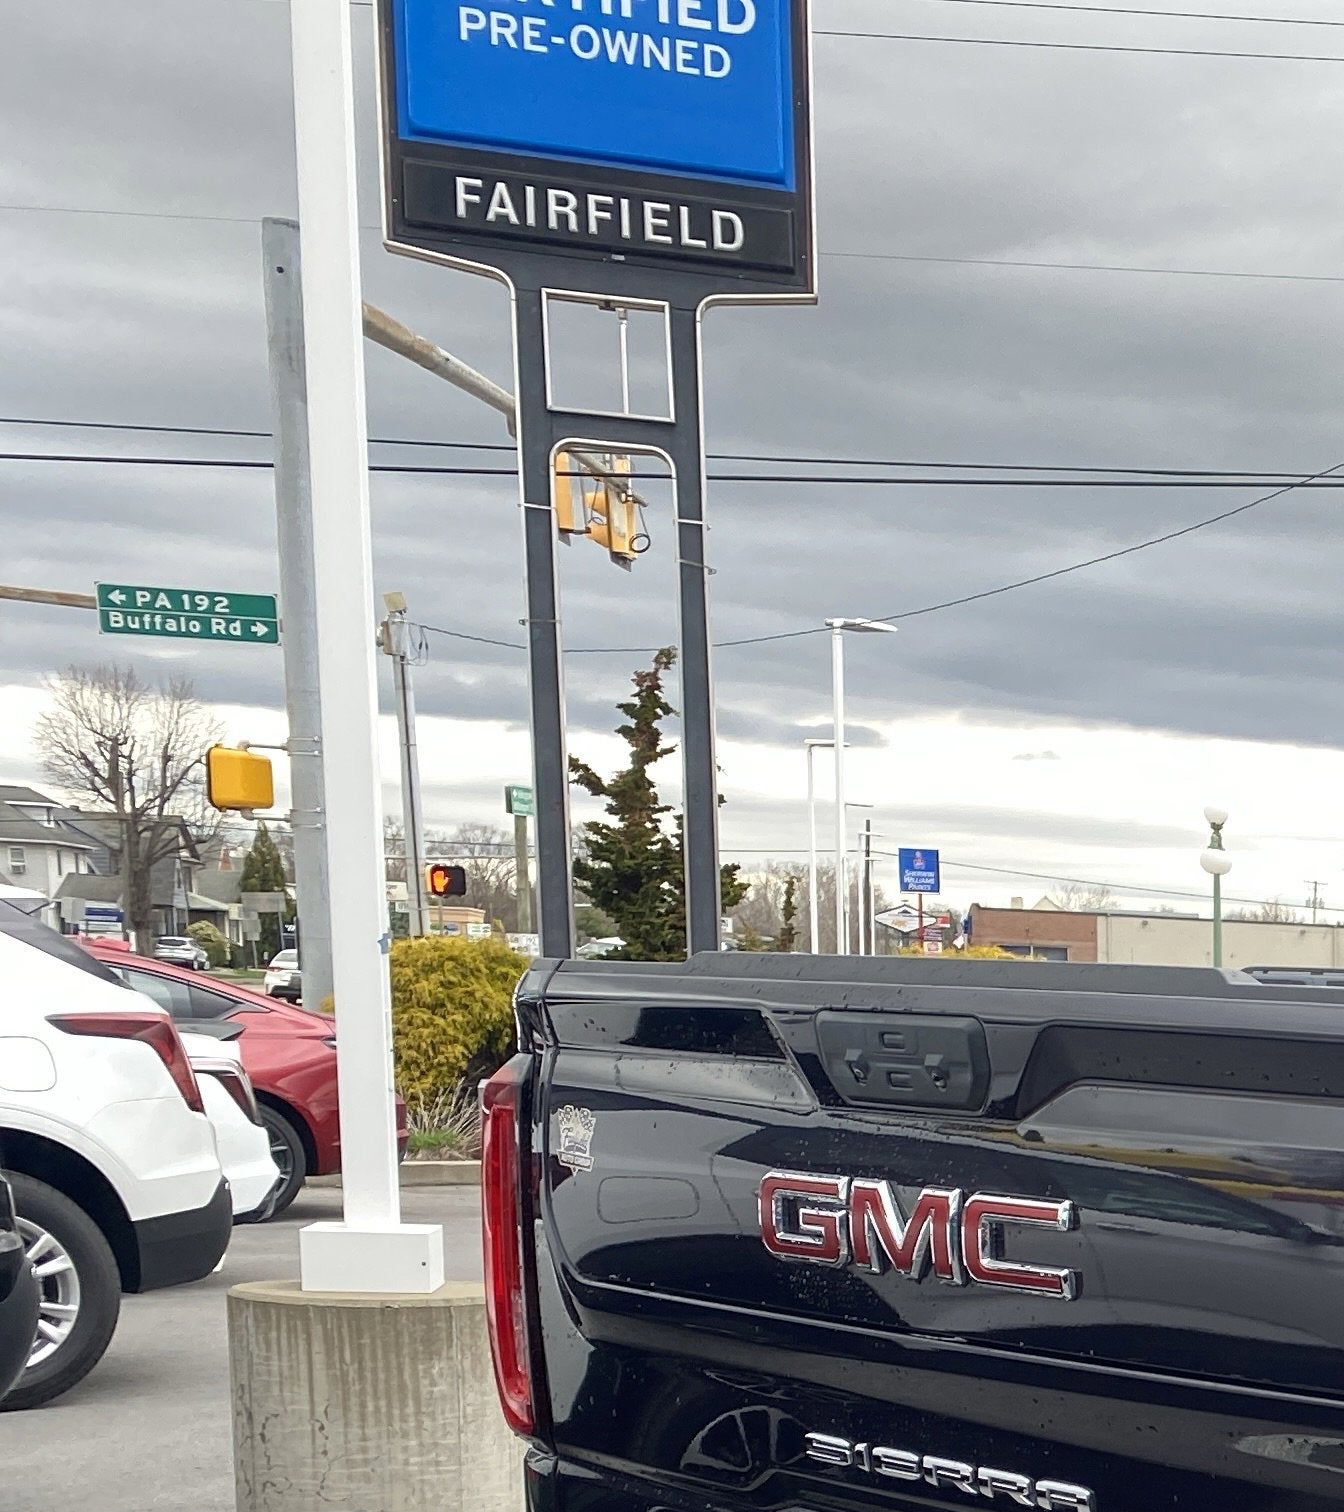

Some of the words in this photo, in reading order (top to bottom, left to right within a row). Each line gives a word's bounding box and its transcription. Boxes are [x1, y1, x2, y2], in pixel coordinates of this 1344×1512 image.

[458, 6, 732, 79] PRE-OWNED
[454, 176, 745, 252] FAIRFIELD
[108, 611, 201, 633] Buffalo
[210, 618, 242, 637] Rd
[135, 590, 172, 609] PA
[181, 593, 230, 613] 192
[758, 1168, 1078, 1301] GMC
